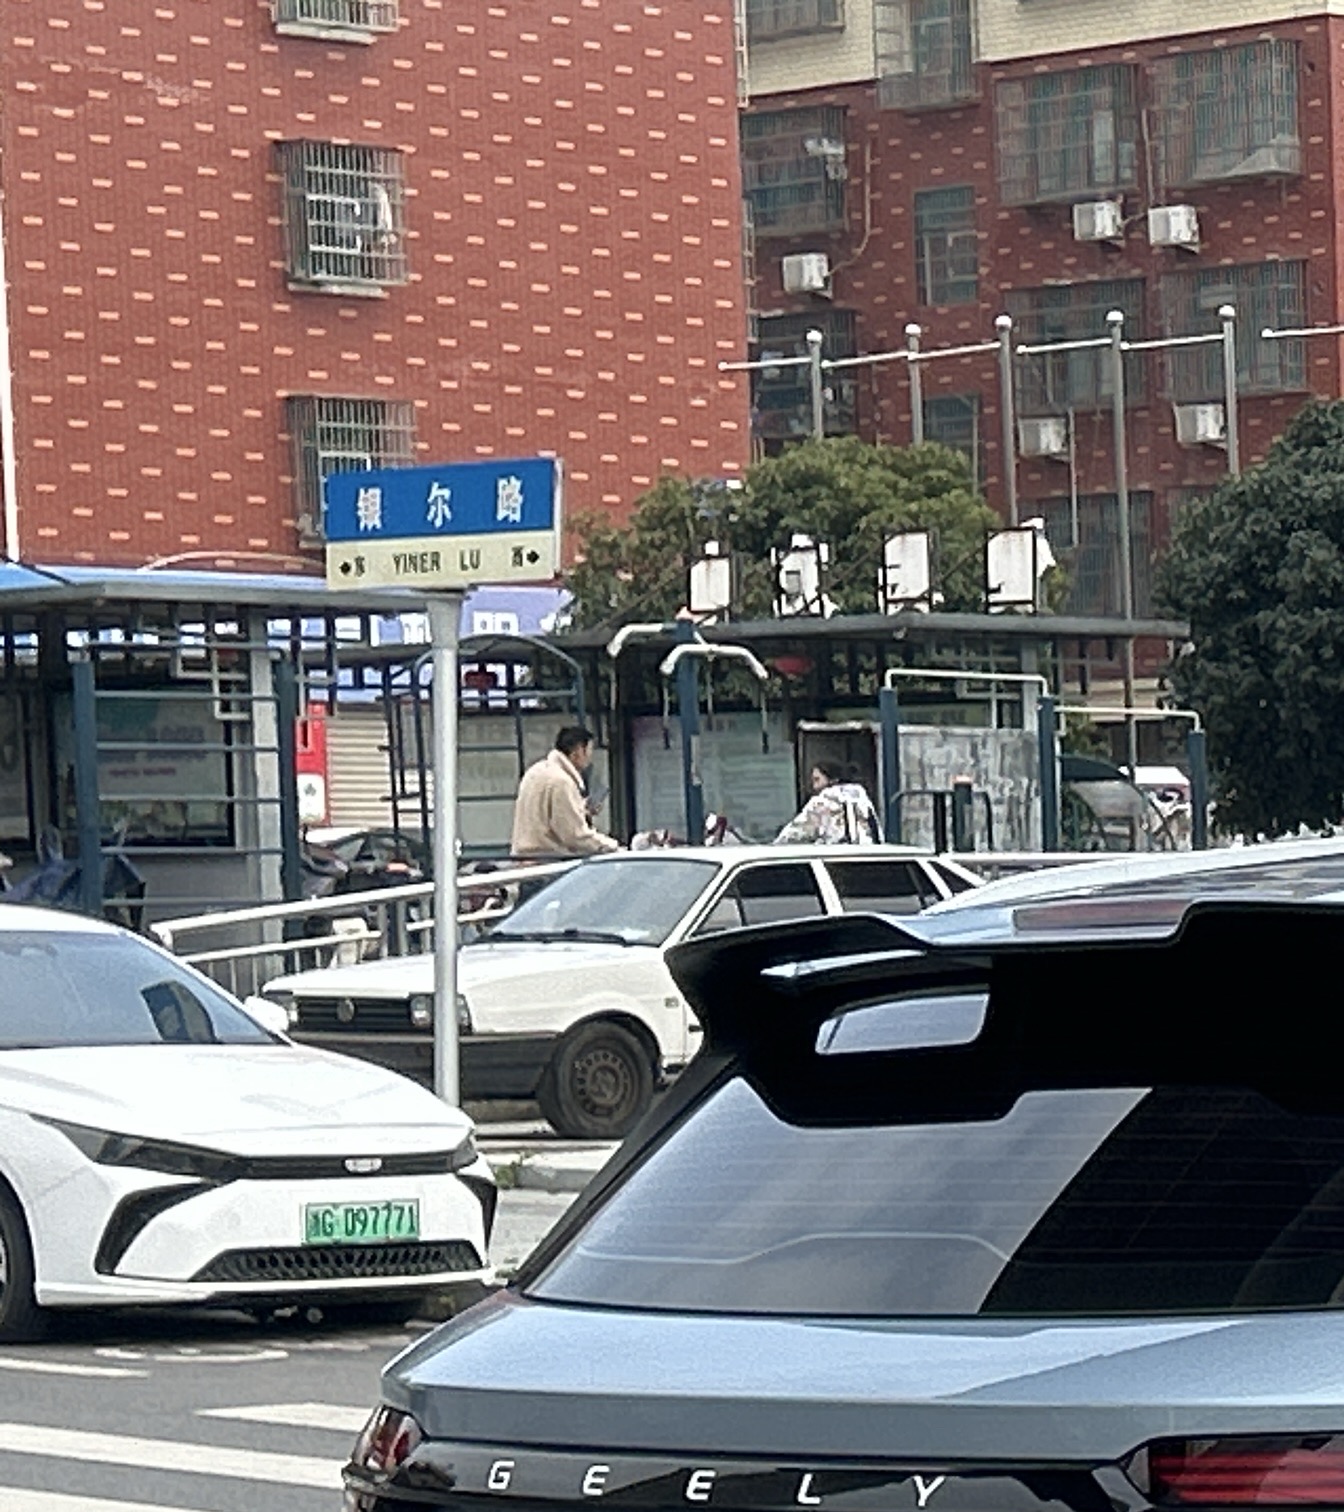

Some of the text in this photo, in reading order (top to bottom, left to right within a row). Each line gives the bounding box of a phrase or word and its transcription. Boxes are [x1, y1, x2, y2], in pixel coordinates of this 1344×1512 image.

[393, 549, 481, 574] YINER LU
[487, 1460, 945, 1507] GEELY
